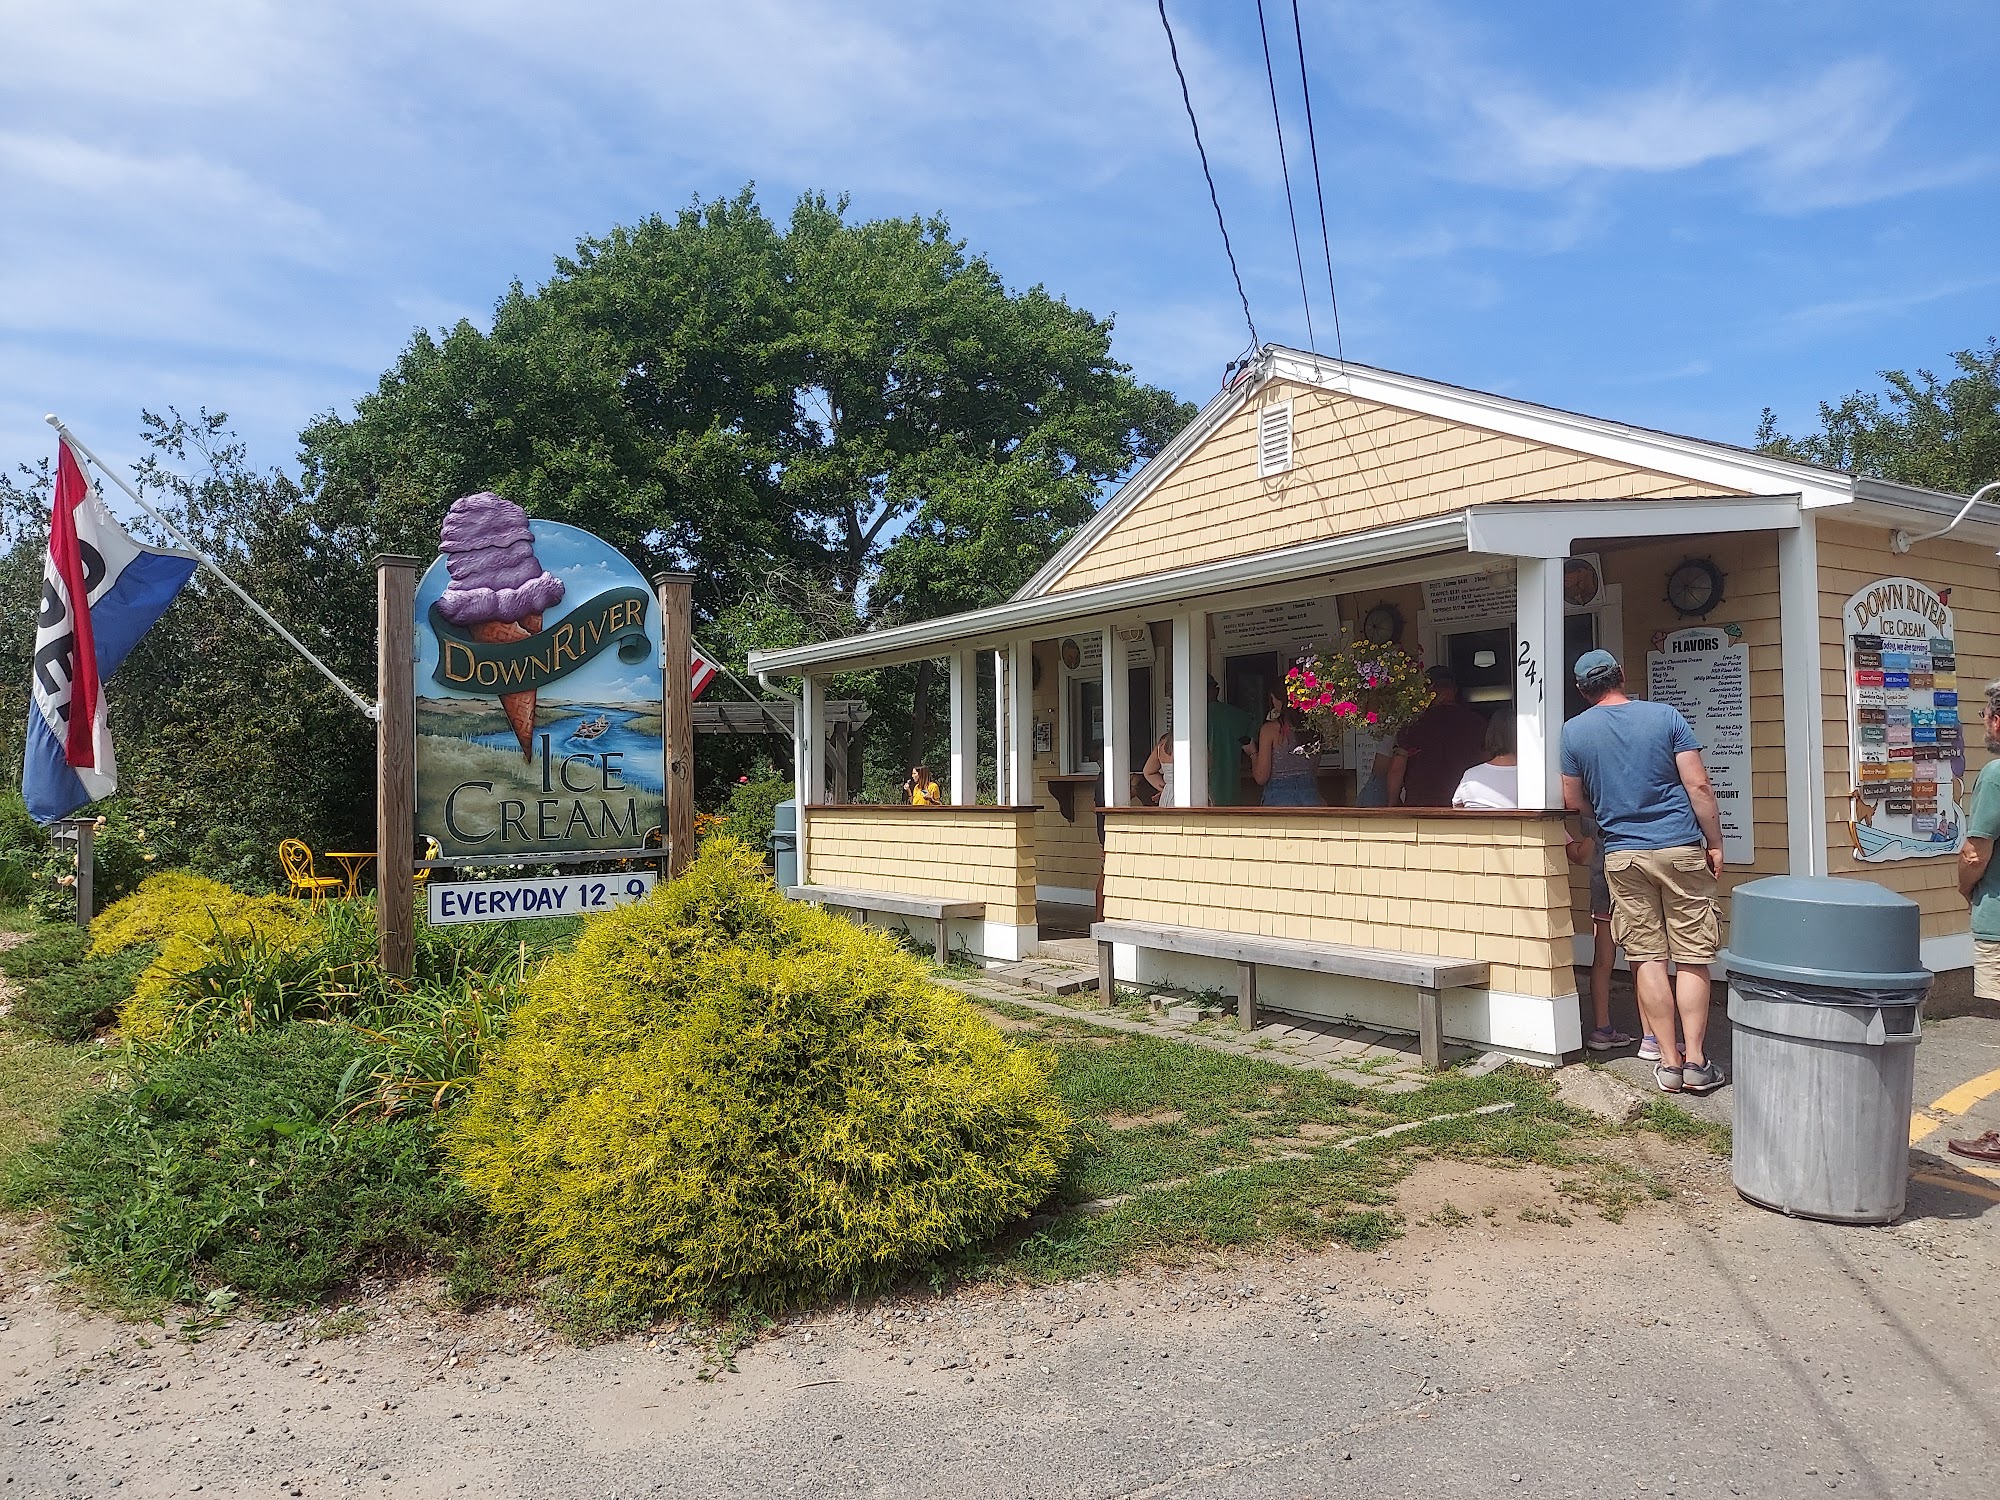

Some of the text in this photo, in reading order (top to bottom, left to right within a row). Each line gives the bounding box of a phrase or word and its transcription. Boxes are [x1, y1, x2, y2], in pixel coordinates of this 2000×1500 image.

[1854, 584, 1947, 638] DOWN RIVER
[1879, 616, 1926, 638] ICE CREAM
[1518, 640, 1543, 703] 241
[1672, 638, 1719, 654] FLAVORS
[540, 733, 626, 793] ICE
[444, 780, 642, 845] CREAM
[441, 886, 568, 917] EVERYDAY
